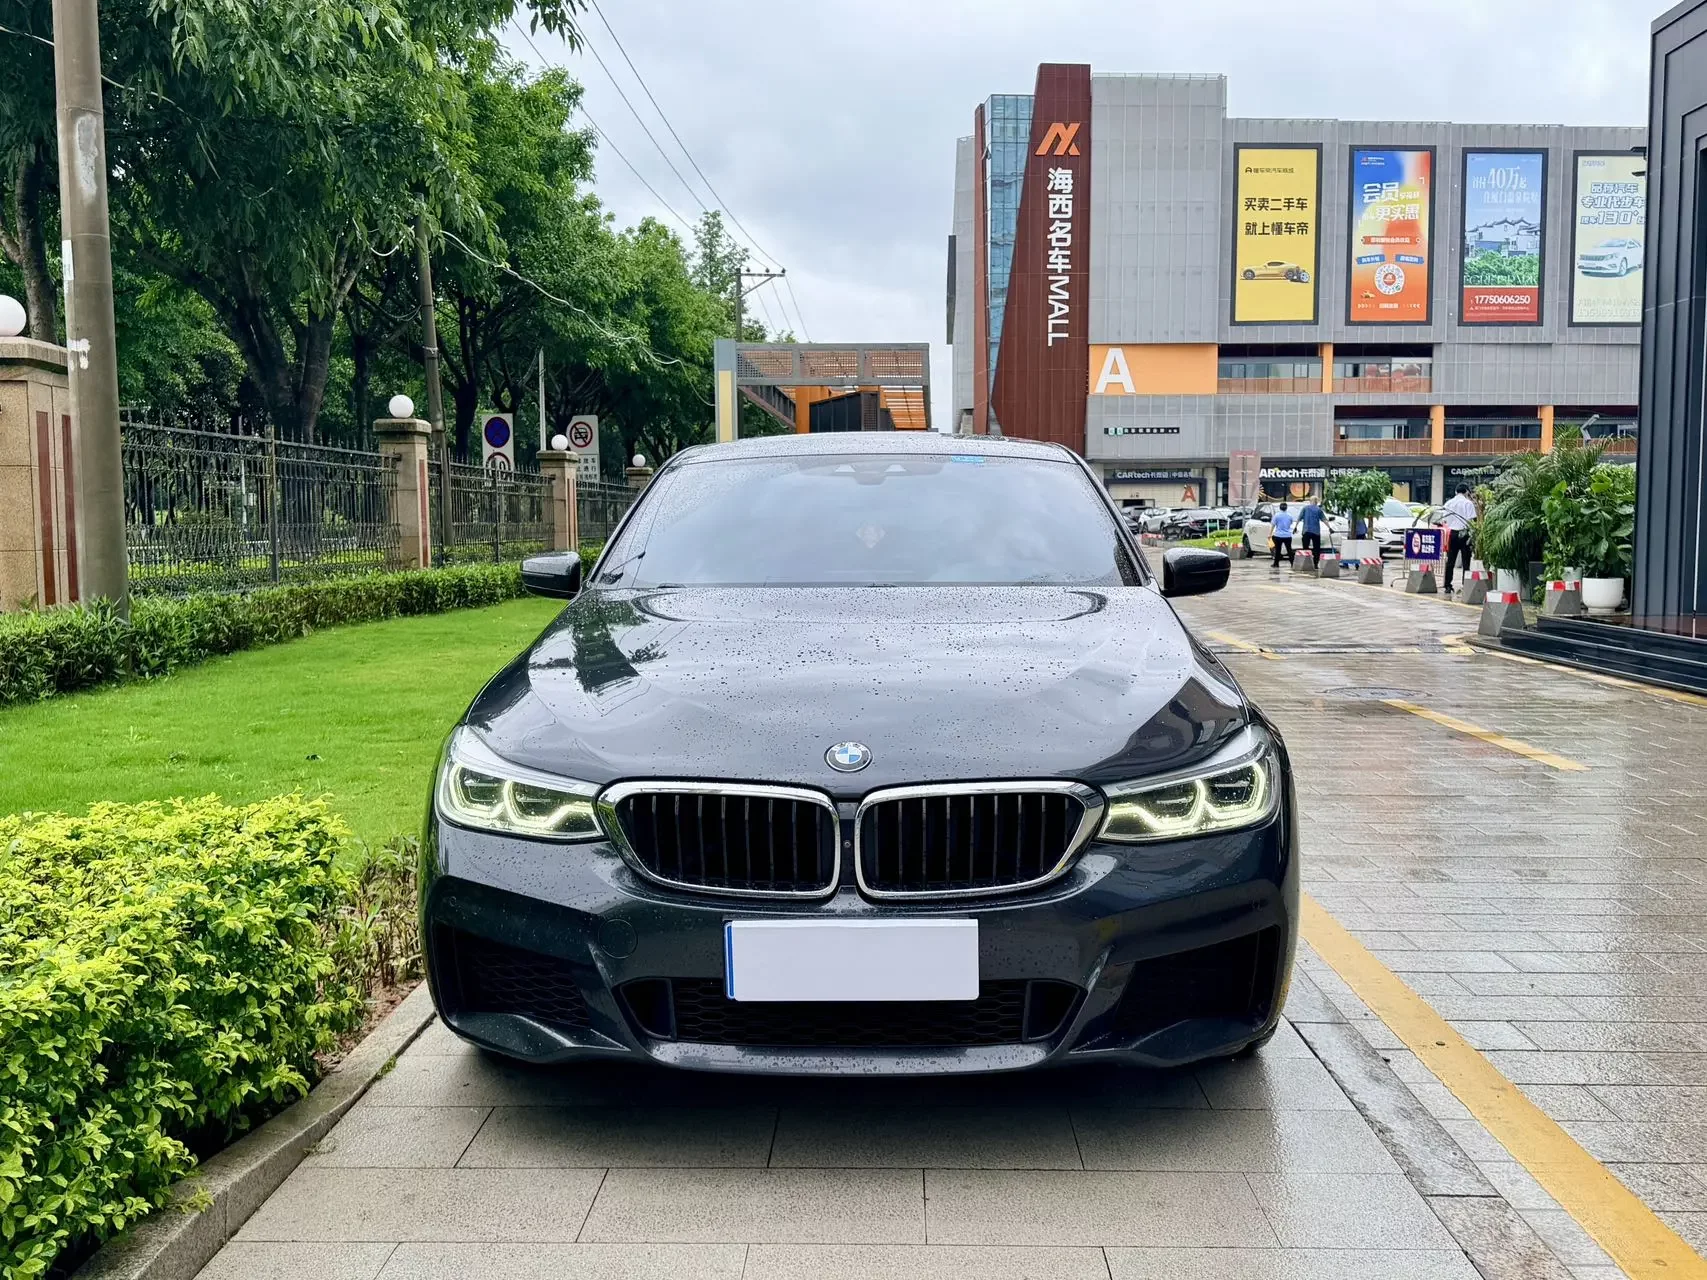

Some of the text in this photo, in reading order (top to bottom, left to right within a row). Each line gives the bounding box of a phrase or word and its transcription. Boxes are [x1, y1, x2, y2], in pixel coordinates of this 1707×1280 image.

[1363, 182, 1400, 203] 会员
[1244, 197, 1308, 212] 买卖二手车
[1580, 195, 1646, 209] 专业代步车
[1244, 221, 1309, 236] 就上懂车帝
[1046, 166, 1074, 347] 海西名车 MALL
[1474, 294, 1532, 305] 17750606250
[1094, 347, 1137, 394] A
